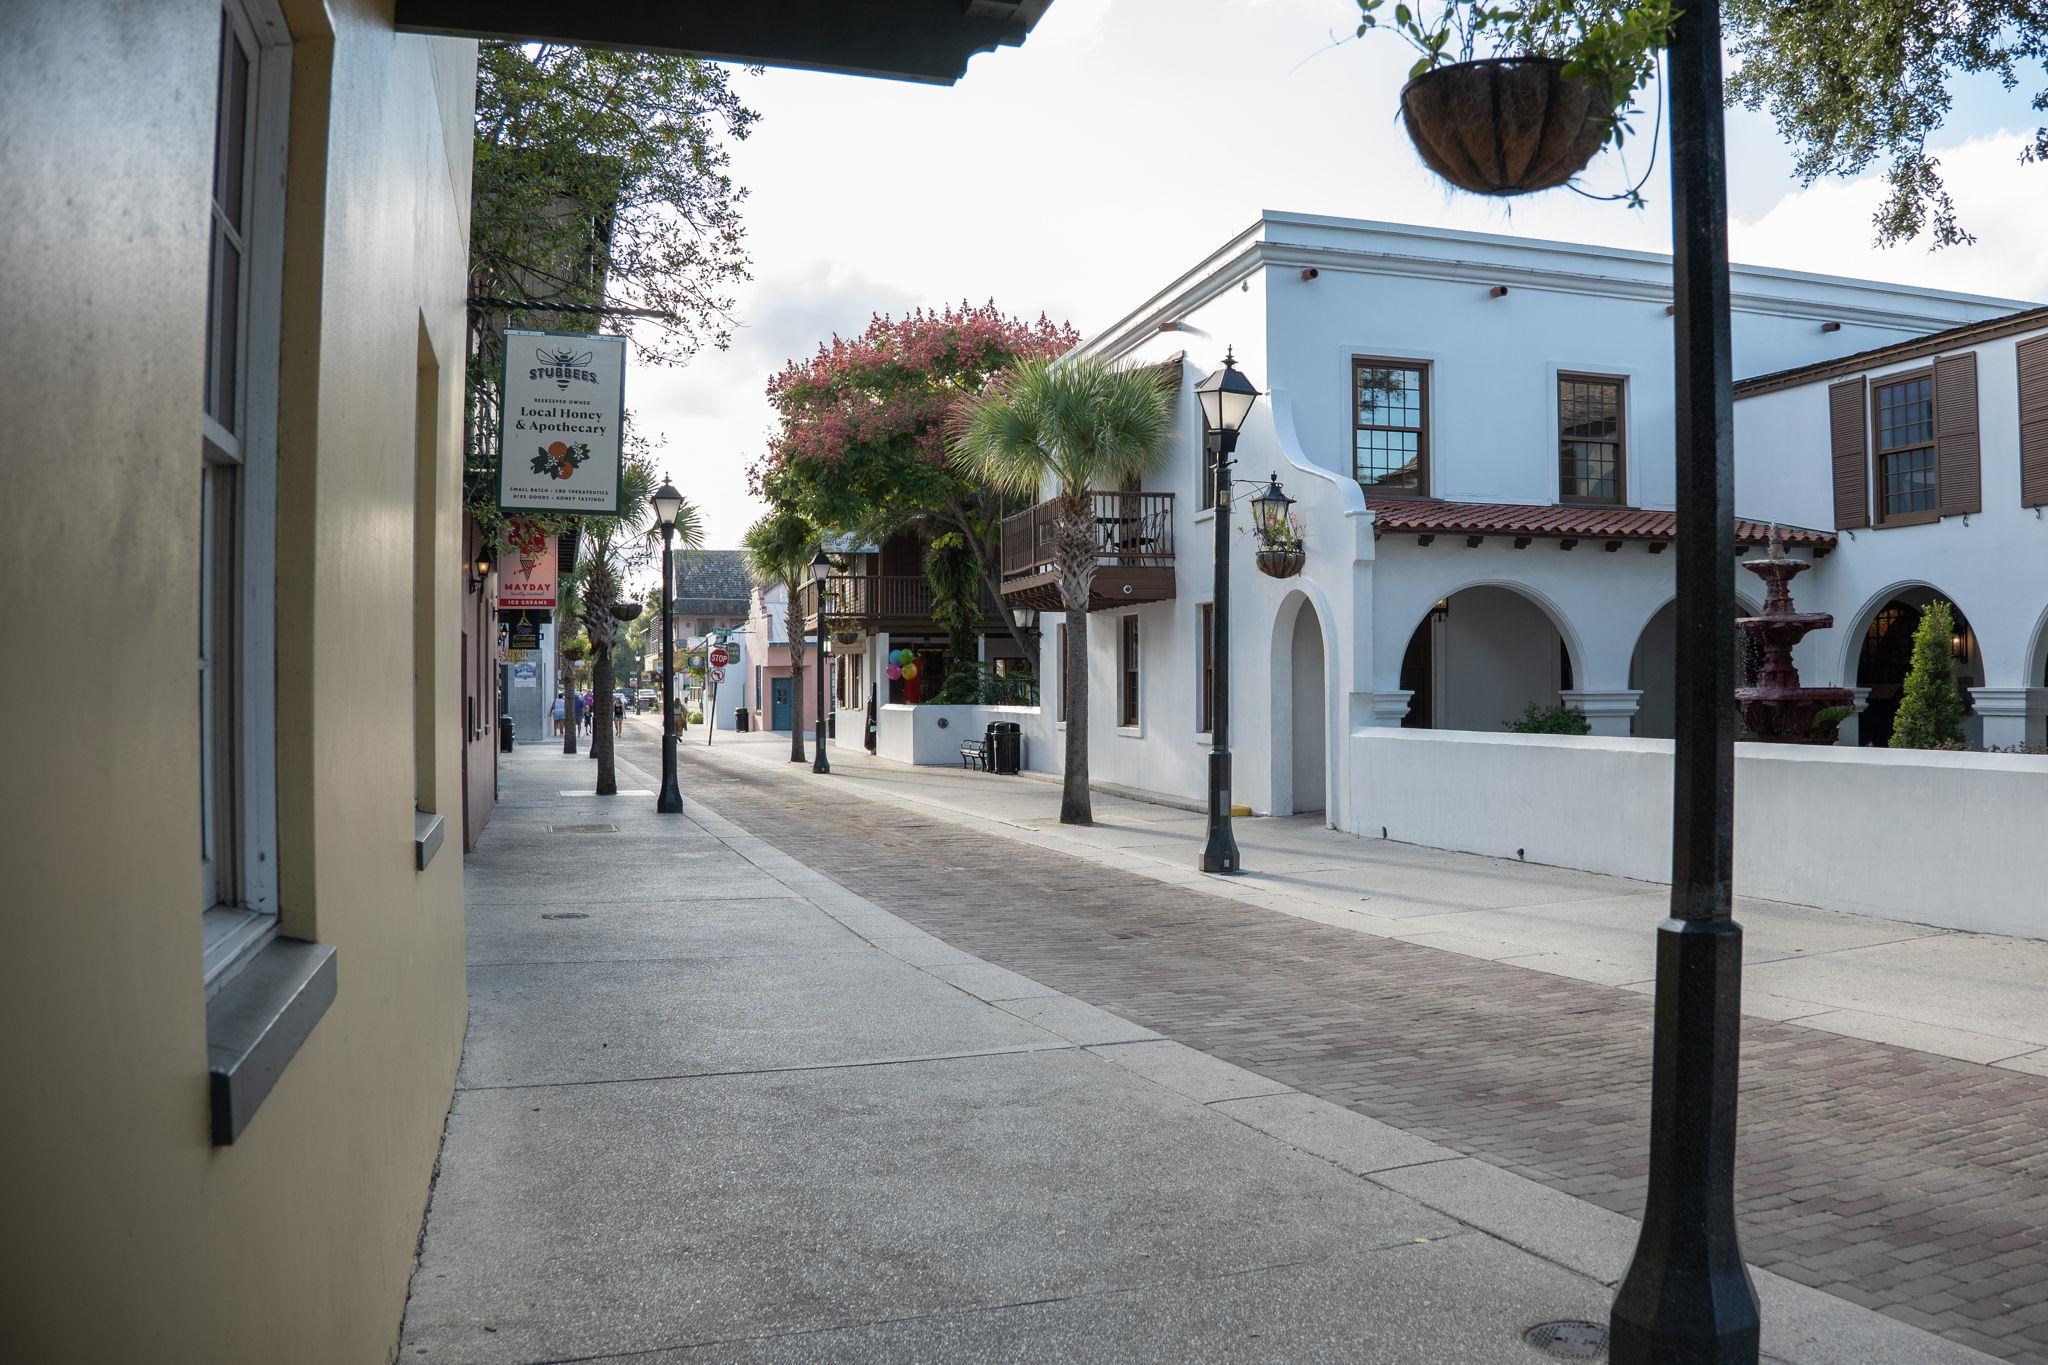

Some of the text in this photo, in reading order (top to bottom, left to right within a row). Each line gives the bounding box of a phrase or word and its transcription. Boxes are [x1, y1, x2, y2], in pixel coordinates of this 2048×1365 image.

[529, 367, 598, 384] STUBBEES
[521, 407, 603, 422] Local Honey
[515, 420, 607, 436] & Apothecary
[504, 583, 551, 591] MAYDAY
[711, 653, 728, 663] STOP
